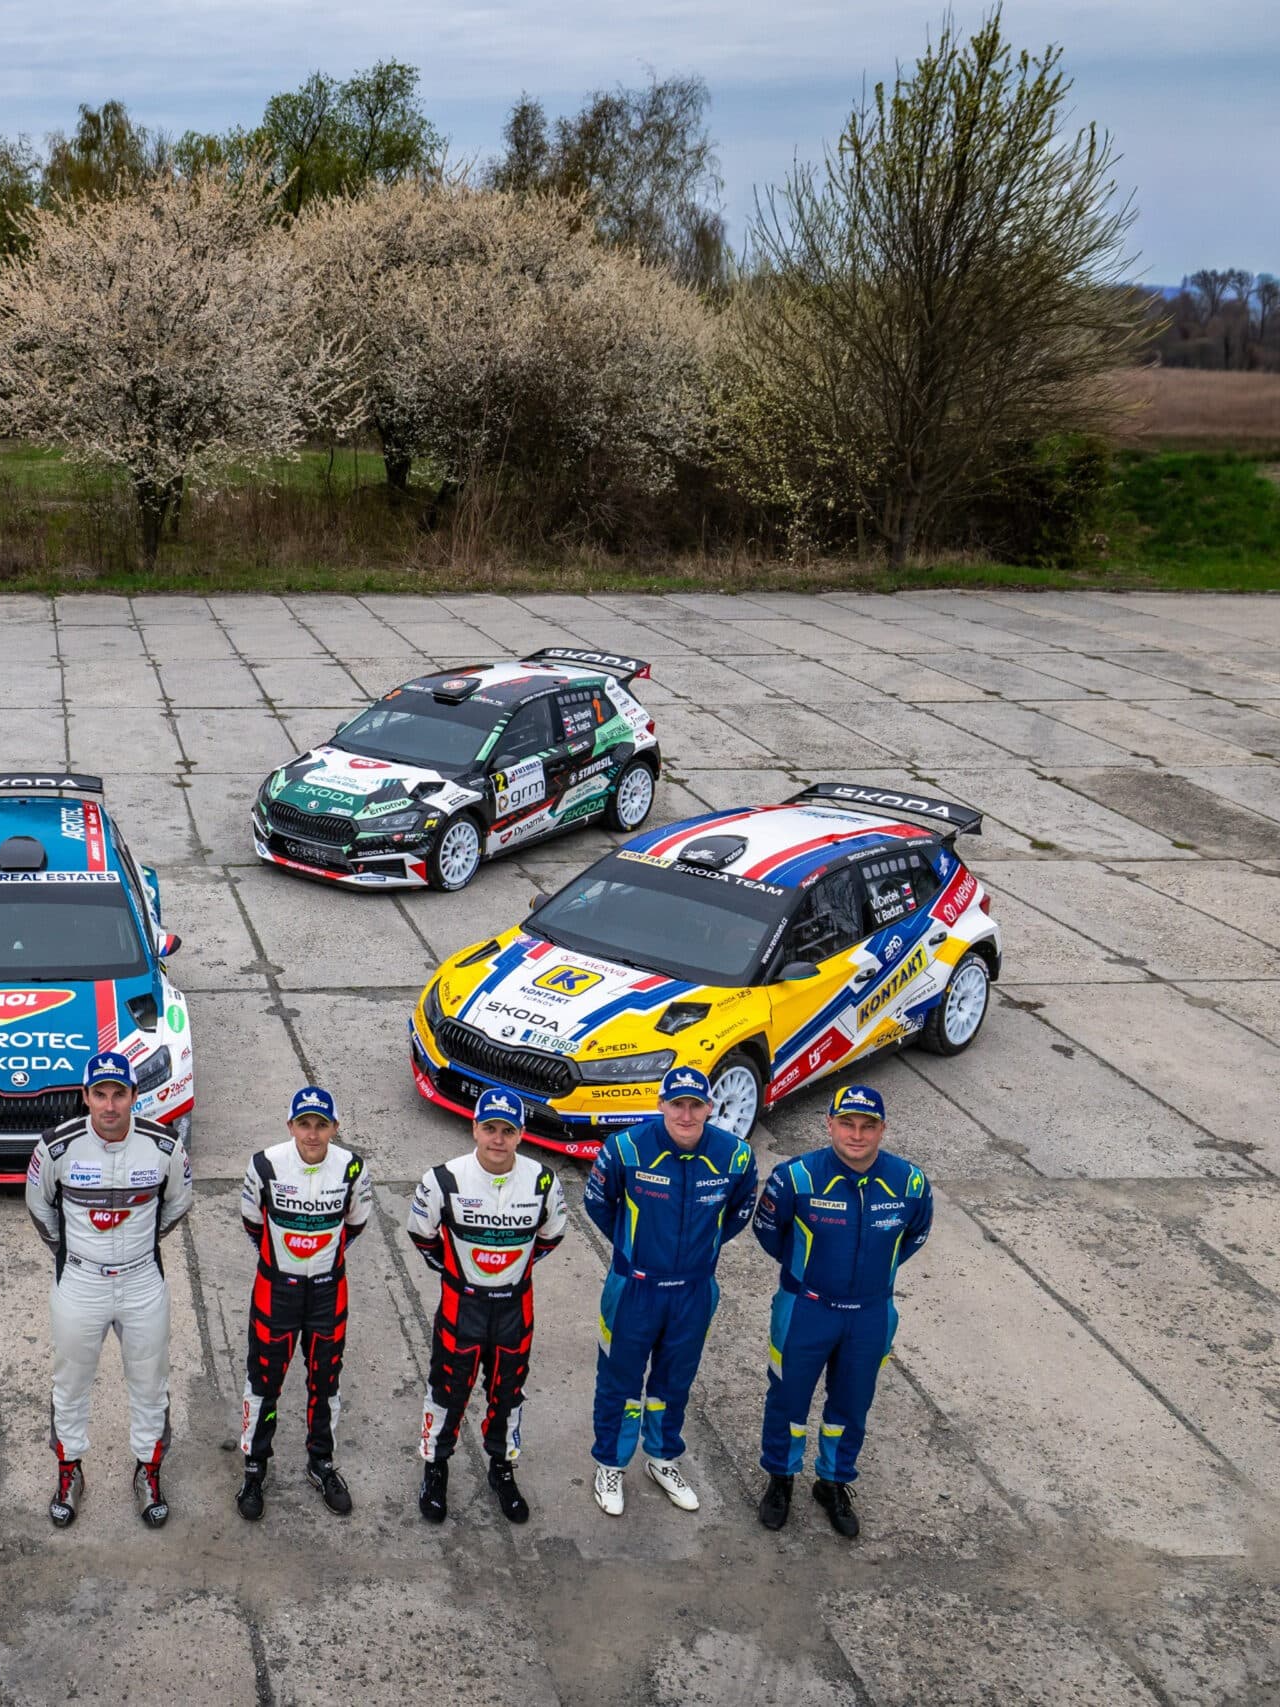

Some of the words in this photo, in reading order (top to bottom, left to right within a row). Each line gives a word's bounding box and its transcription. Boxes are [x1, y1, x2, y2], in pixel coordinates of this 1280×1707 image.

[578, 756, 613, 780] STAVOSIL
[495, 773, 506, 791] 2
[510, 780, 544, 807] grm
[621, 851, 671, 866] KONTAKT
[0, 873, 41, 882] REAL
[46, 873, 116, 881] ESTATES
[736, 878, 784, 896] TEAM
[547, 970, 589, 990] K
[859, 949, 925, 1024] KONTAKT
[520, 985, 572, 1005] KONTAKT
[530, 1032, 548, 1045] 11R
[551, 1039, 580, 1052] 0602
[645, 1087, 658, 1095] Plu
[582, 1145, 600, 1154] me
[71, 1174, 91, 1182] EVRO
[637, 1173, 669, 1184] KONTAKT
[275, 1193, 342, 1212] Emotive
[93, 1212, 120, 1223] MOL
[463, 1210, 533, 1227] Emotive
[288, 1236, 319, 1249] MOL
[476, 1252, 507, 1265] MOL
